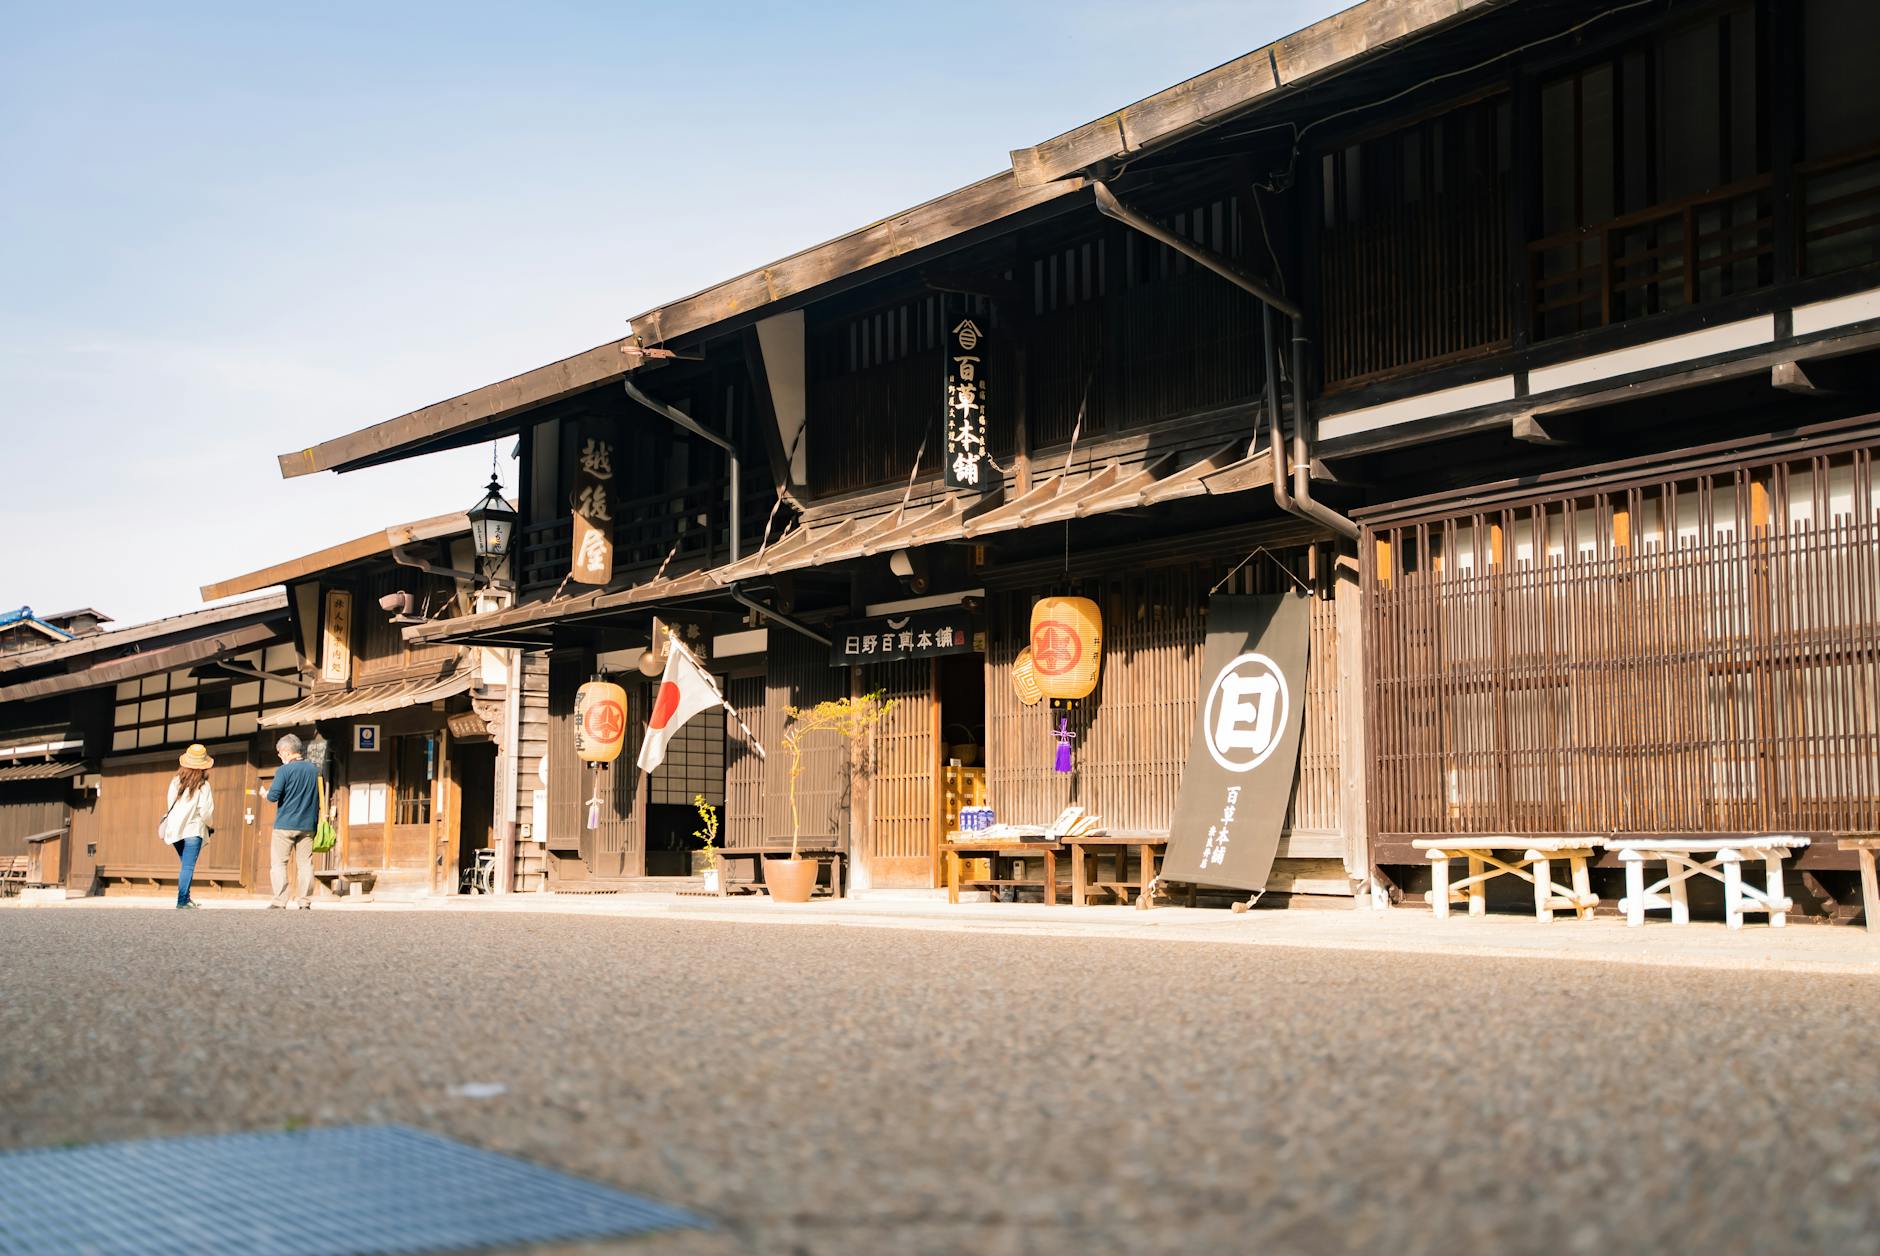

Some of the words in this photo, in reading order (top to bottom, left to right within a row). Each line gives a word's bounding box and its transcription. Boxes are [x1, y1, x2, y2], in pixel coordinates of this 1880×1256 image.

[952, 355, 982, 486] 百草本舗
[577, 437, 613, 572] 越後屋
[1211, 786, 1242, 866] 百草本舗
